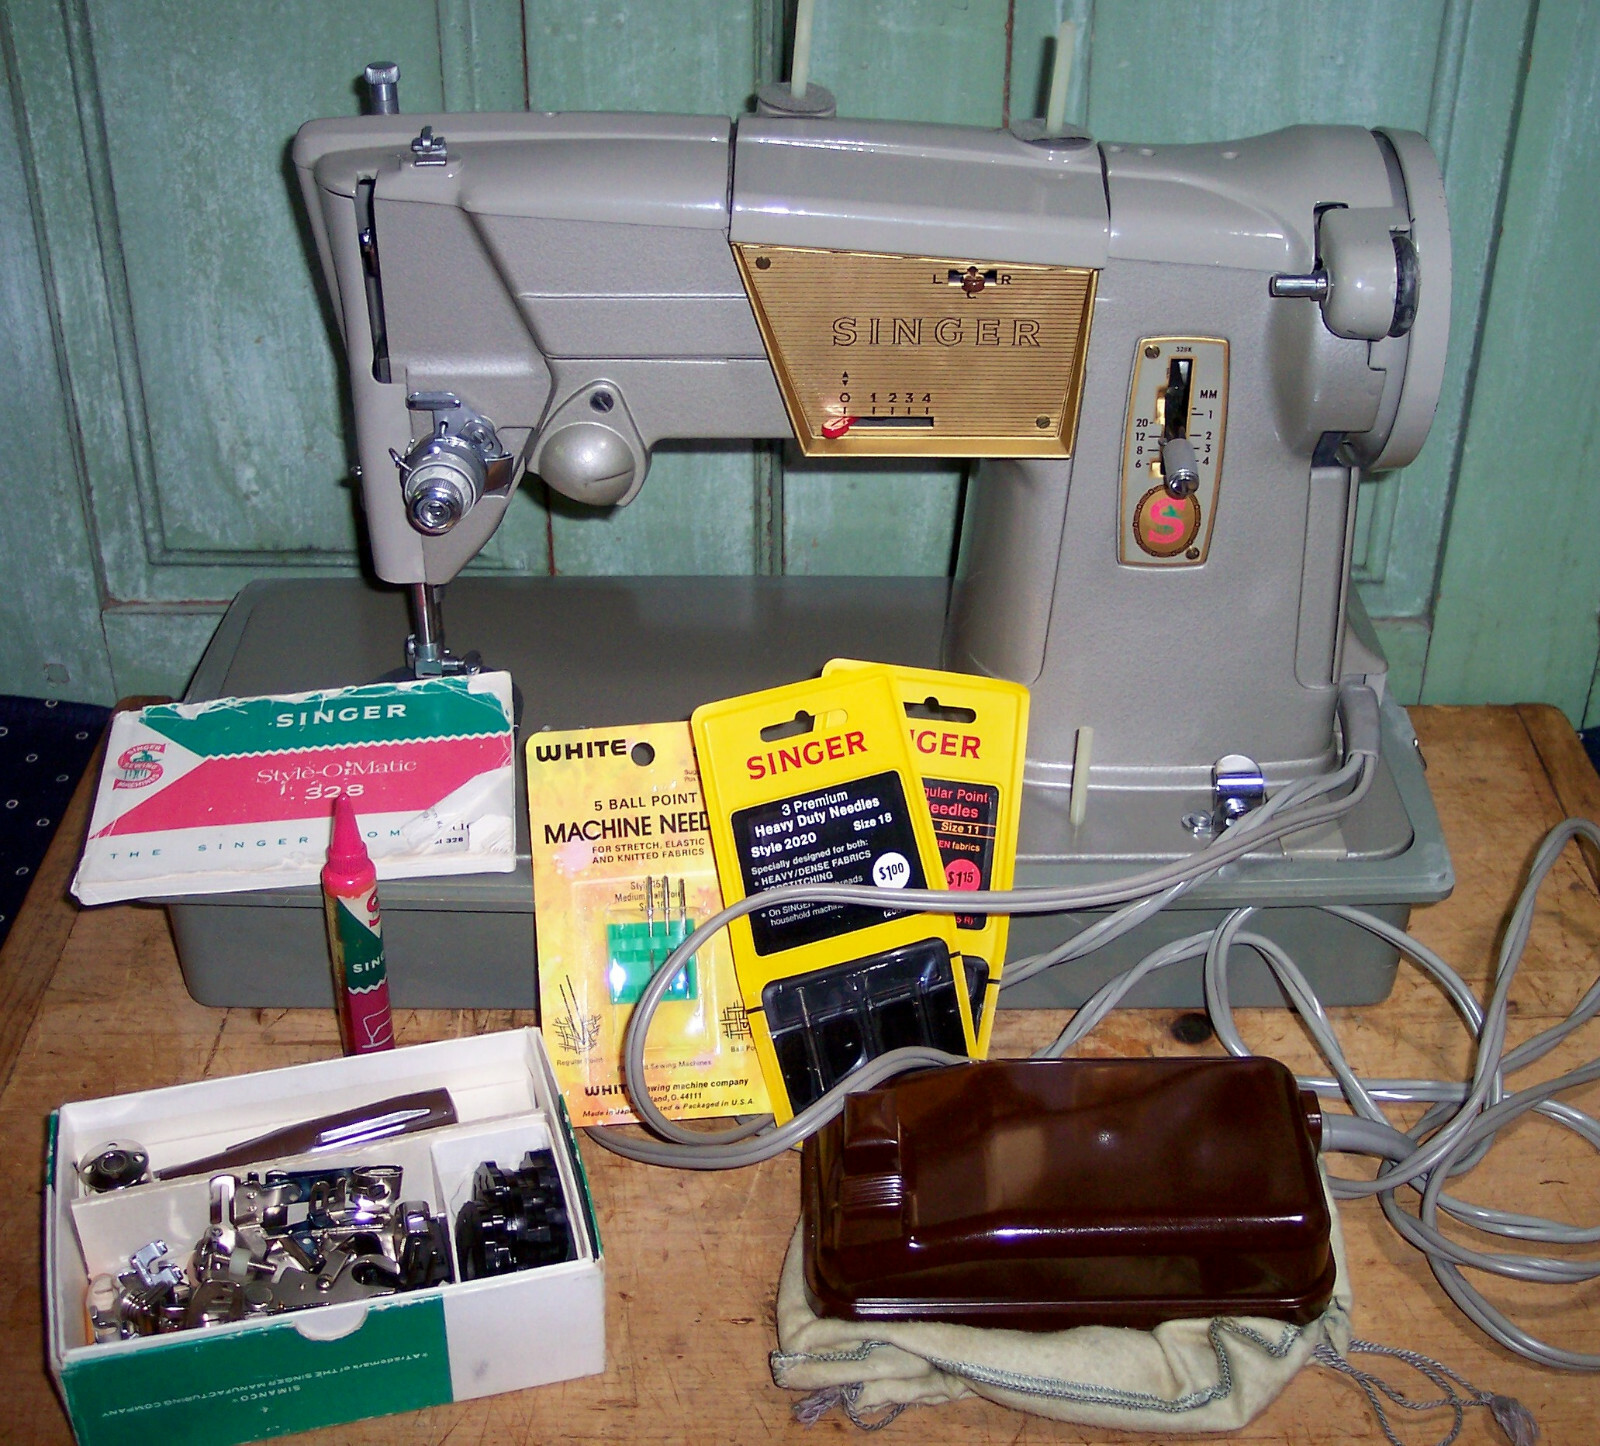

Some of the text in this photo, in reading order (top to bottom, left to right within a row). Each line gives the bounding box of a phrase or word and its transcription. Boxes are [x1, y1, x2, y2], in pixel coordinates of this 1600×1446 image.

[933, 274, 943, 285] L
[1001, 275, 1012, 285] R
[832, 316, 1041, 347] SINGER
[839, 392, 931, 403] 0 1 2 3 4
[1200, 389, 1218, 399] MM
[1136, 410, 1213, 427] 20 1
[1135, 431, 1212, 441] 12 2
[1136, 444, 1211, 455] 8 3
[1135, 457, 1209, 468] 6 4
[276, 704, 407, 728] SINGER
[535, 739, 627, 762] WHITE
[910, 729, 981, 759] GER
[746, 731, 868, 780] SINGER
[304, 783, 365, 800] 328
[957, 789, 989, 803] Point
[594, 792, 698, 812] 5 BALL POINT
[781, 791, 848, 816] 3 Premium
[928, 801, 979, 818] eedles
[754, 797, 880, 838] Heavy Duty Needles
[853, 812, 893, 831] Size 18
[544, 815, 652, 844] MACHINE
[941, 821, 980, 834] Size 11
[110, 836, 310, 860] THE SINGER
[592, 845, 612, 854] FOR
[665, 838, 705, 848] ELASTIC
[750, 831, 817, 858] Style 2020
[937, 840, 980, 852] EN fabrics
[592, 848, 705, 864] AND KNITTED FABRICS
[751, 839, 869, 875] Specially designed for both:
[761, 850, 872, 885] HEAVY/DENSE FABRICS
[770, 910, 811, 927] household
[673, 1080, 709, 1090] machine
[711, 1078, 749, 1088] company
[680, 1092, 702, 1100] 44111
[683, 1100, 719, 1109] Packaged
[102, 1401, 162, 1417] COMPANY
